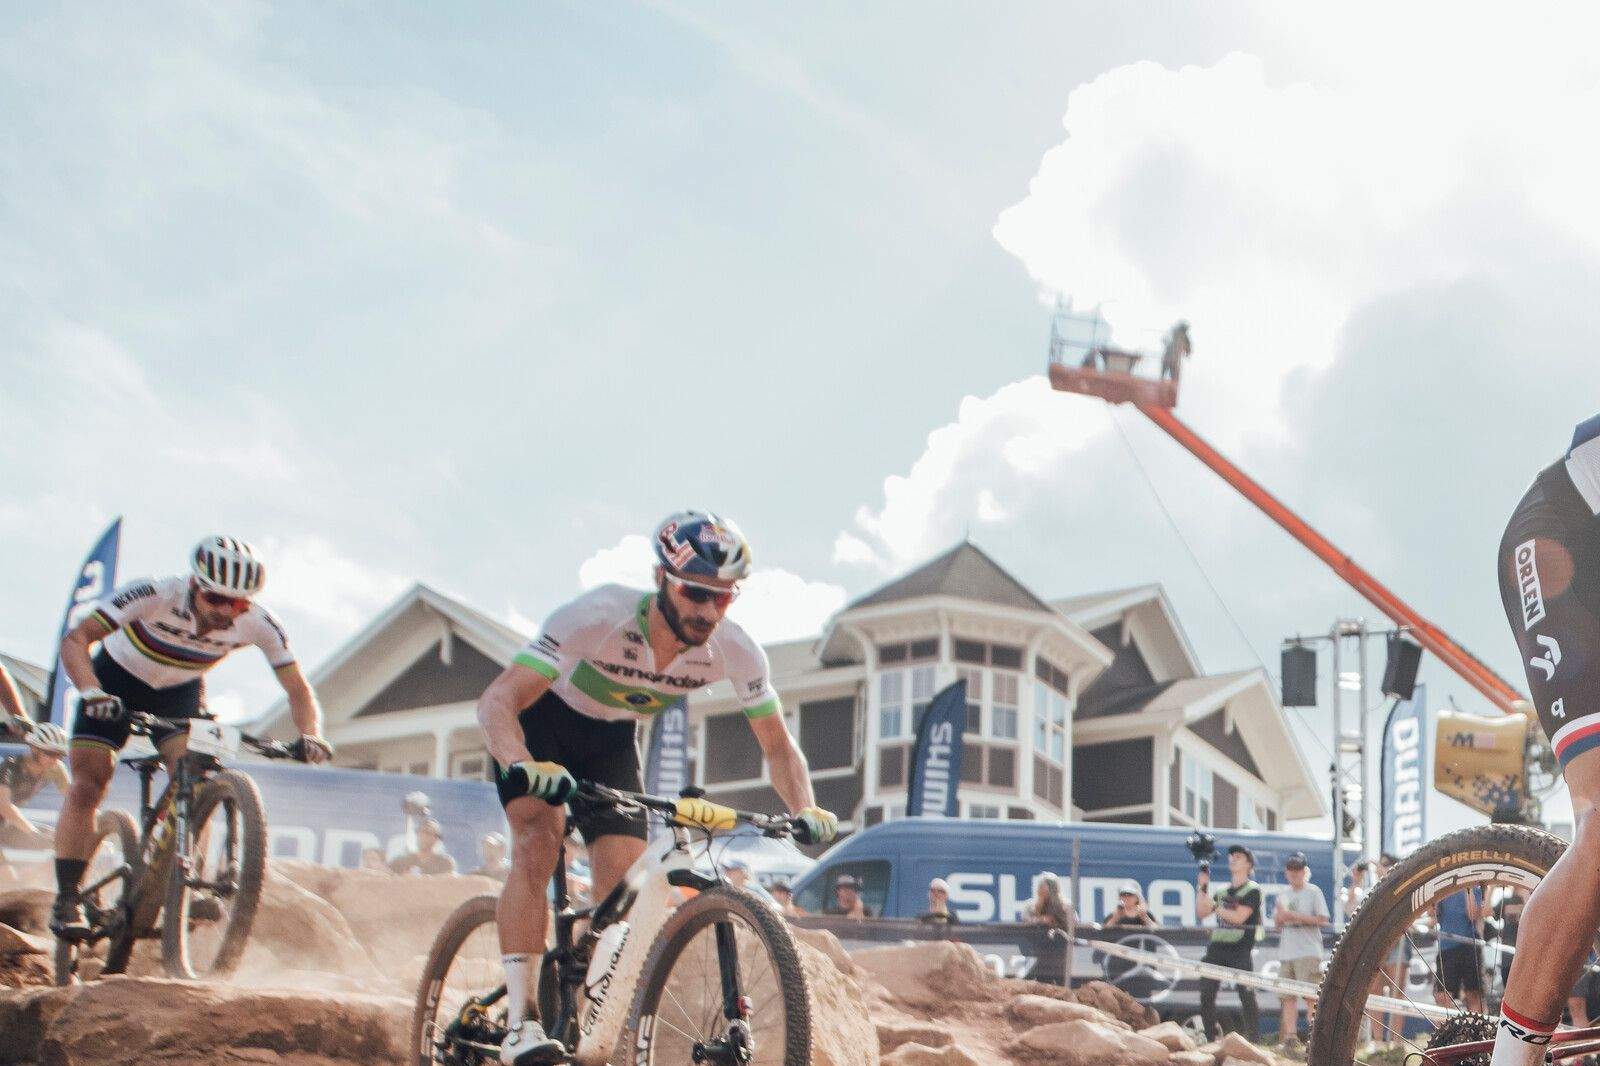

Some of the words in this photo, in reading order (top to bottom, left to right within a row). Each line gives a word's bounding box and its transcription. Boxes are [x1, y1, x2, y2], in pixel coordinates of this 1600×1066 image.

[1517, 547, 1541, 622] ORLEN
[592, 658, 707, 689] cannondal
[658, 707, 685, 799] SHIM
[923, 721, 952, 815] SHIM
[1392, 717, 1421, 858] MANO
[1440, 850, 1512, 868] PIRELLI
